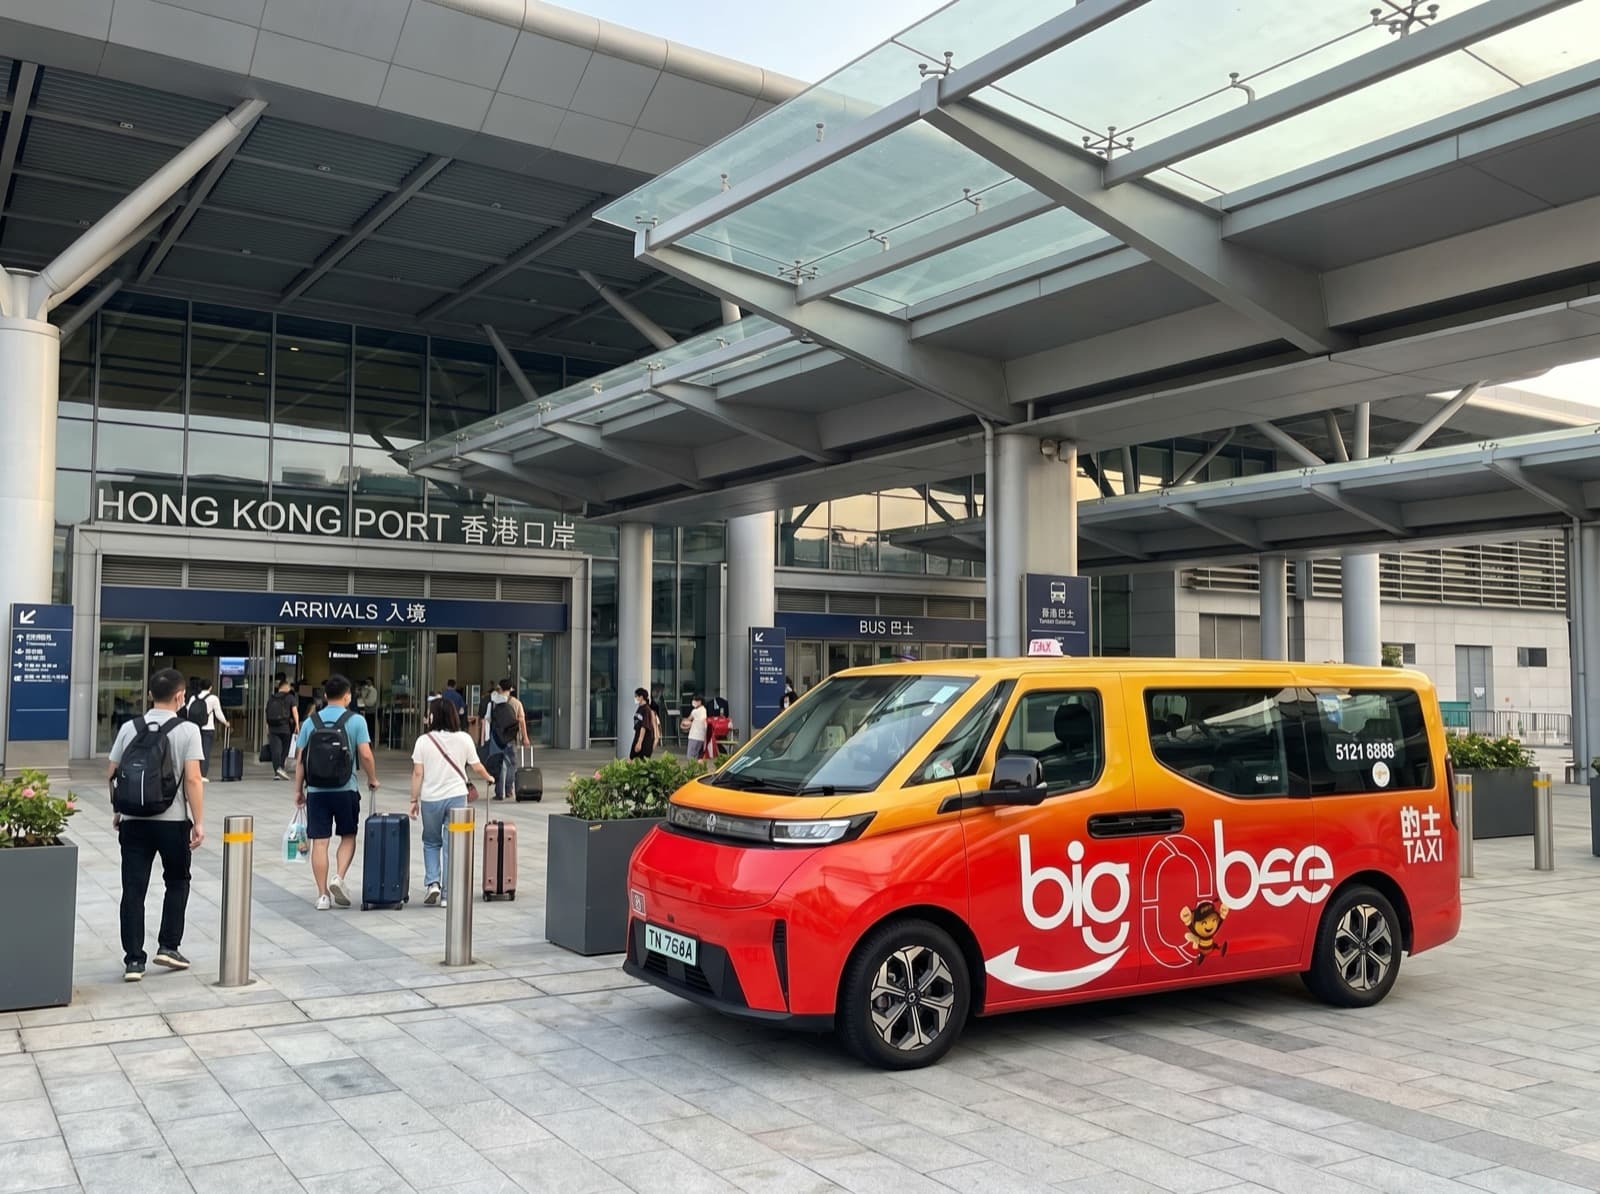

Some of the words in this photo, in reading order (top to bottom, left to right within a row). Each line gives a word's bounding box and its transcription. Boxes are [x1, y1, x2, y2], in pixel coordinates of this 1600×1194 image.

[98, 488, 219, 526] HONG
[232, 498, 342, 534] KONG
[354, 508, 451, 542] PORT
[460, 514, 576, 549] 香港口岸
[279, 600, 378, 620] ARRIVALS
[385, 602, 427, 624] 入境
[860, 619, 887, 635] BUS
[890, 620, 915, 636] 巴士
[1335, 743, 1364, 761] 5121
[1366, 742, 1395, 760] 6888
[1400, 805, 1441, 838] 的士
[1402, 838, 1443, 864] TAXI
[1018, 833, 1131, 954] big
[1212, 819, 1335, 910] bee
[648, 928, 662, 950] TN
